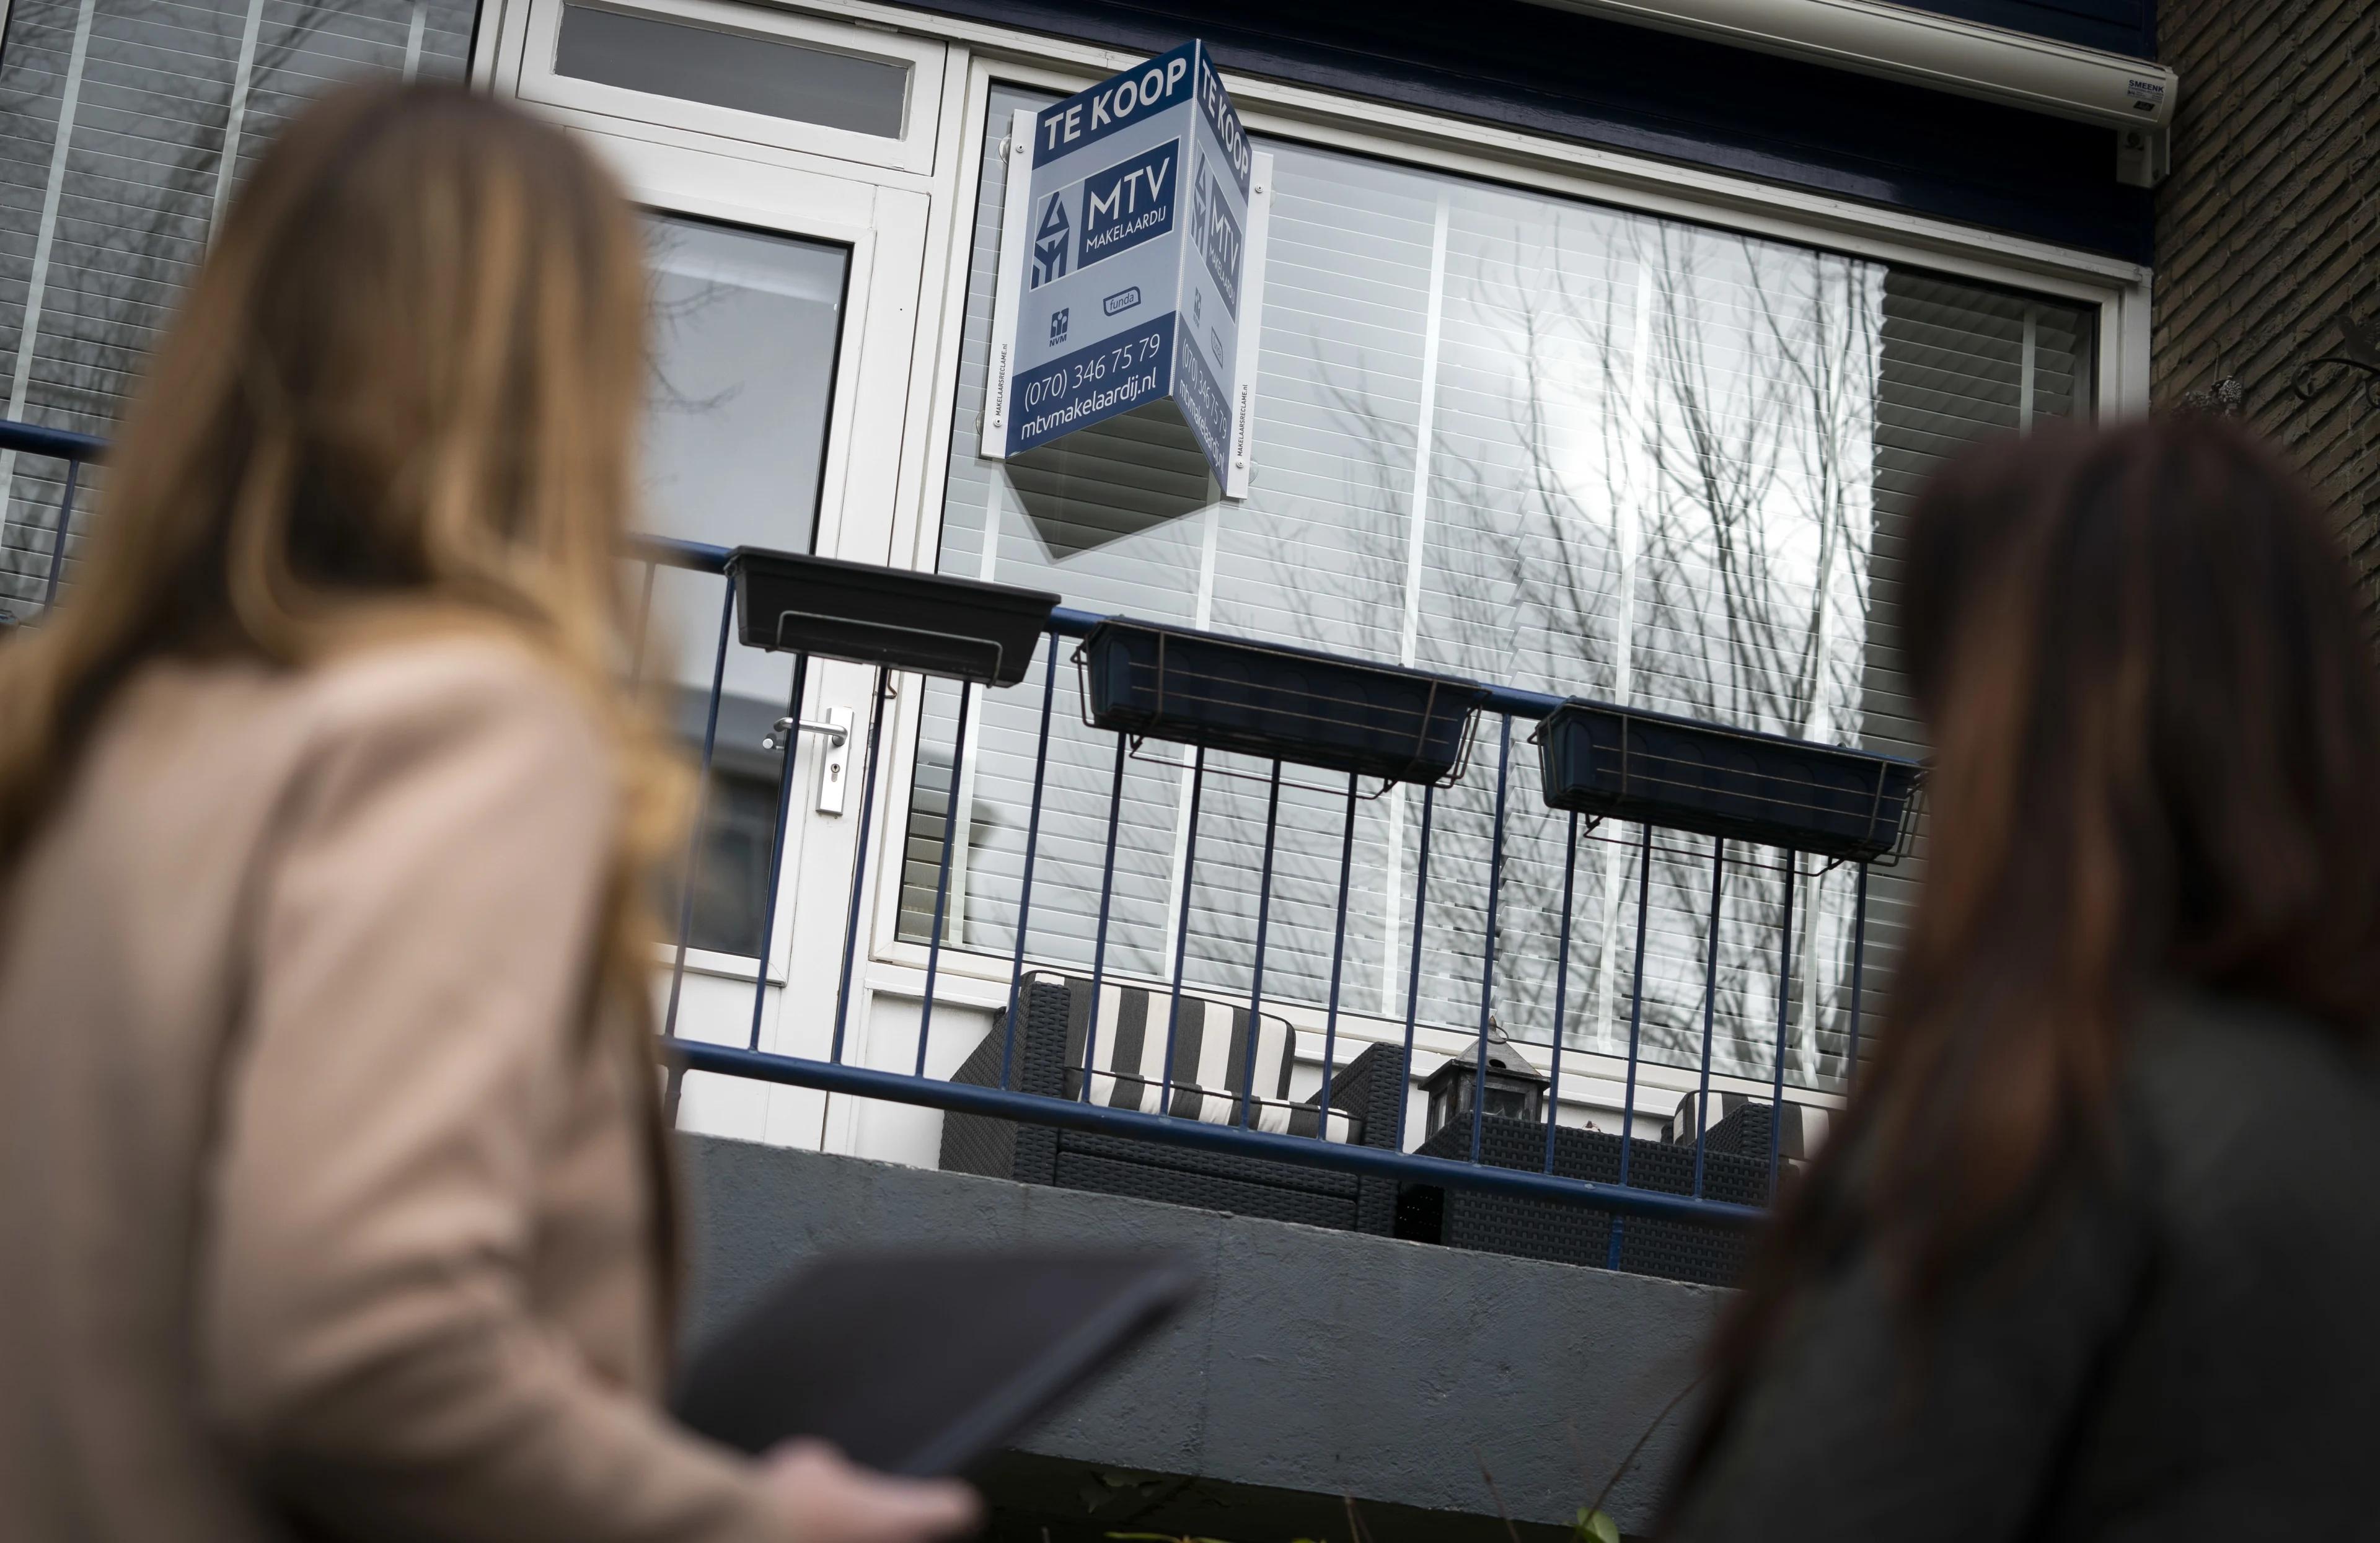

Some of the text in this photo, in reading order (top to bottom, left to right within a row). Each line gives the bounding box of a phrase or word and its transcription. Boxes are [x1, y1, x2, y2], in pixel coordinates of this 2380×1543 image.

[1044, 58, 1188, 151] TE KOOP
[1202, 58, 1249, 181] TE KOOP
[2129, 79, 2164, 93] SMEENK
[1086, 205, 1166, 253] MAKELAARDIJ
[1088, 157, 1170, 231] MTV
[1211, 196, 1239, 276] MTV
[1109, 292, 1135, 311] funda
[1209, 242, 1235, 305] MAKELAARDIJ
[1025, 333, 1161, 412] (070) 346 75 79
[1049, 333, 1067, 348] NVM
[995, 343, 1008, 416] MAKELAARSRECLAME.nl
[1021, 367, 1156, 440] mtvmakelaardij.nl
[1183, 338, 1227, 439] (070) 346 75 79
[1179, 379, 1225, 475] mtvmakelaardij.nl
[1237, 384, 1248, 457] MAKELAARSRECLAME.nl
